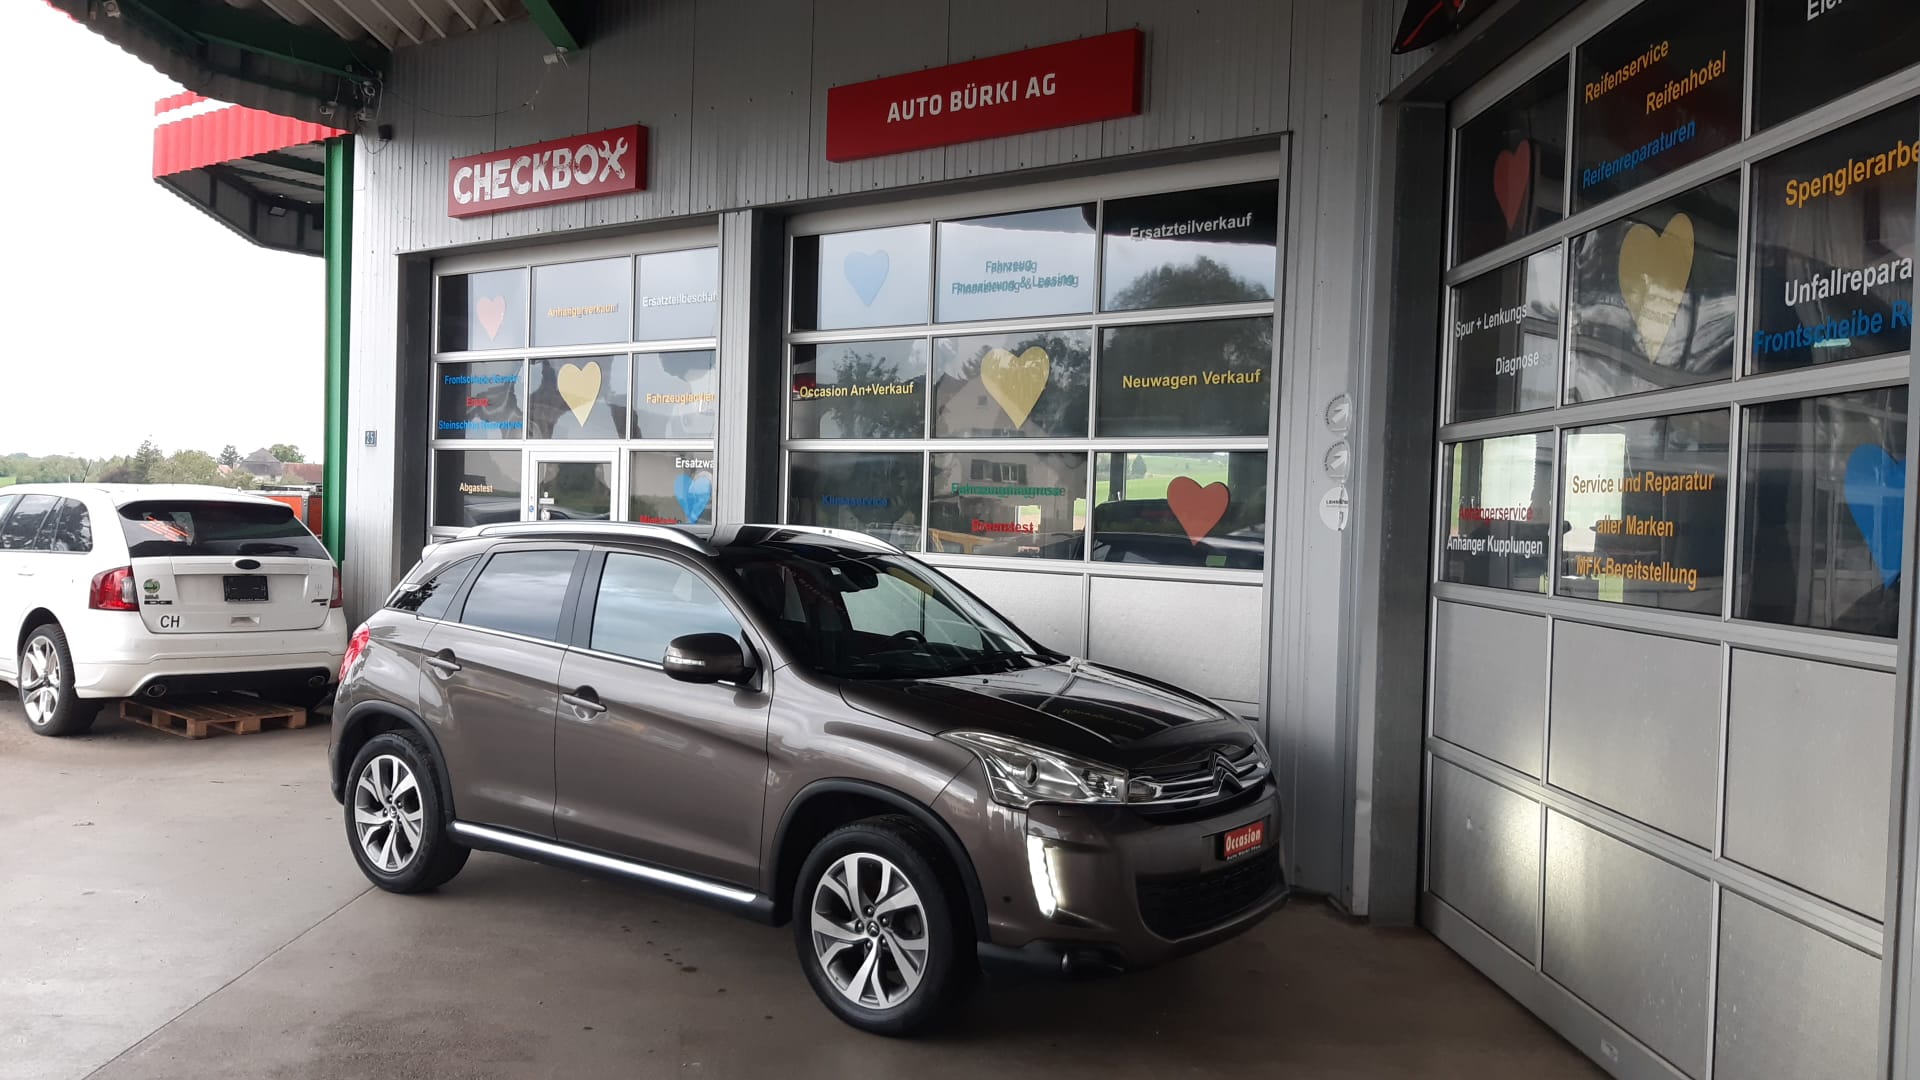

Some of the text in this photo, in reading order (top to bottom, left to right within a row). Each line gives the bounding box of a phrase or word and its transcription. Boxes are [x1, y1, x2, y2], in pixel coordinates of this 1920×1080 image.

[1807, 0, 1842, 21] Ele
[1585, 40, 1669, 104] Reifenservice
[1646, 50, 1726, 115] Reifenhotel
[887, 73, 1056, 123] AUTO BÜRKI AG
[1583, 120, 1696, 190] Reifenreparaturen
[453, 136, 628, 205] CHECKBOX
[1130, 212, 1252, 241] Ersatzteilverkauf
[1785, 257, 1913, 306] Unfallrepara
[1455, 304, 1527, 341] Spur + Lenkungs
[1754, 308, 1883, 354] Frontscheibe
[1495, 351, 1540, 376] Diagnose
[800, 381, 914, 398] Occasion An+Verkauf
[1122, 368, 1261, 390] Neuwagen Verkauf
[459, 482, 493, 494] Abgastest
[1572, 470, 1715, 496] Service und Reparatur
[1597, 515, 1673, 537] aller Marken
[1447, 534, 1543, 559] Anhänger Kupplungen
[1576, 554, 1697, 591] MFK-Bereitstellung
[160, 615, 180, 629] CH
[1225, 828, 1261, 852] Occasion
